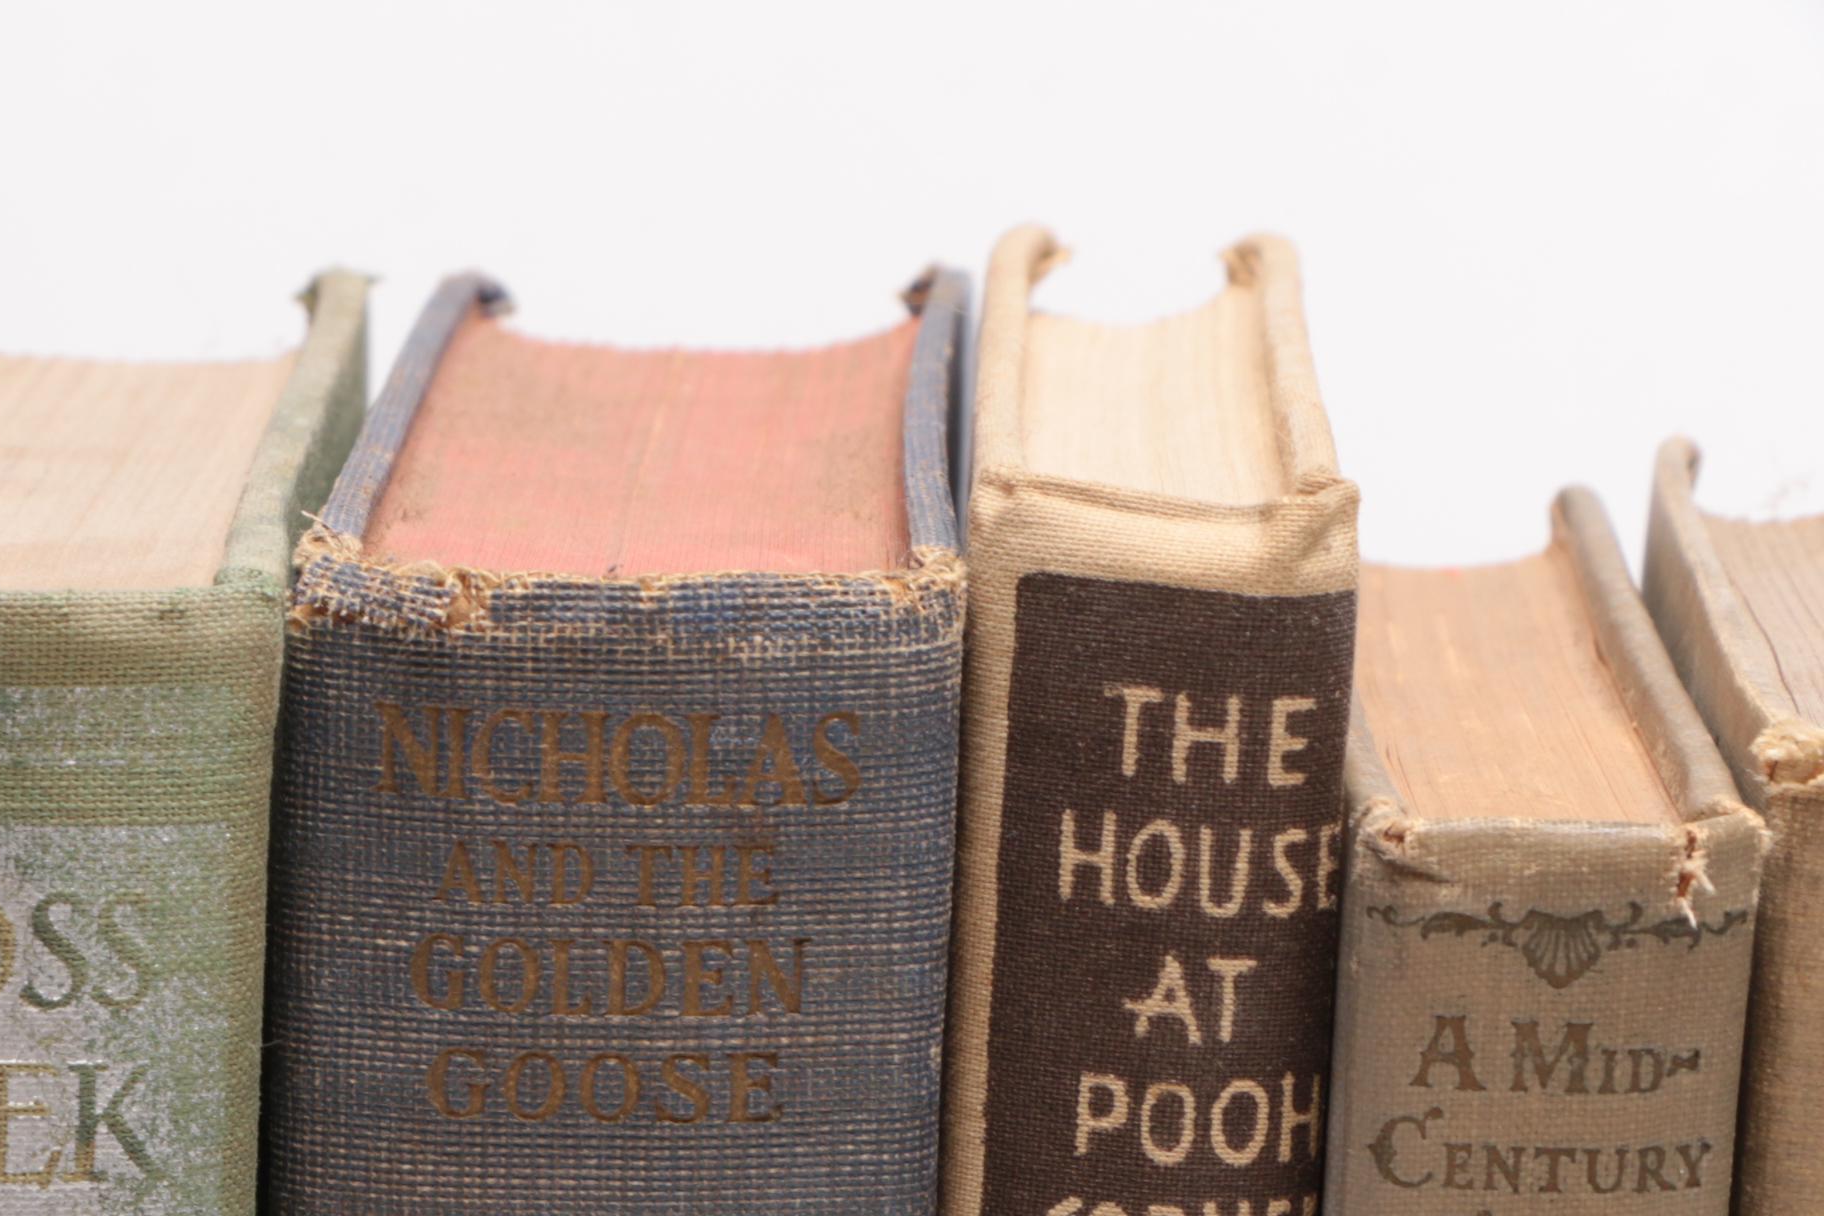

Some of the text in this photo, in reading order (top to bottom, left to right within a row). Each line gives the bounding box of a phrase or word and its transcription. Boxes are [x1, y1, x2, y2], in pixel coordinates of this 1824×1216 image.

[376, 702, 863, 806] NICHOLAS
[1102, 684, 1318, 786] THE
[434, 838, 777, 908] AND THE
[1056, 808, 1341, 918] HOUSE
[409, 932, 813, 1018] GOLDEN
[1123, 954, 1258, 1044] AT
[424, 1046, 785, 1123] GOOSE
[1408, 1015, 1486, 1092] A
[1368, 1106, 1712, 1196] CENTURY
